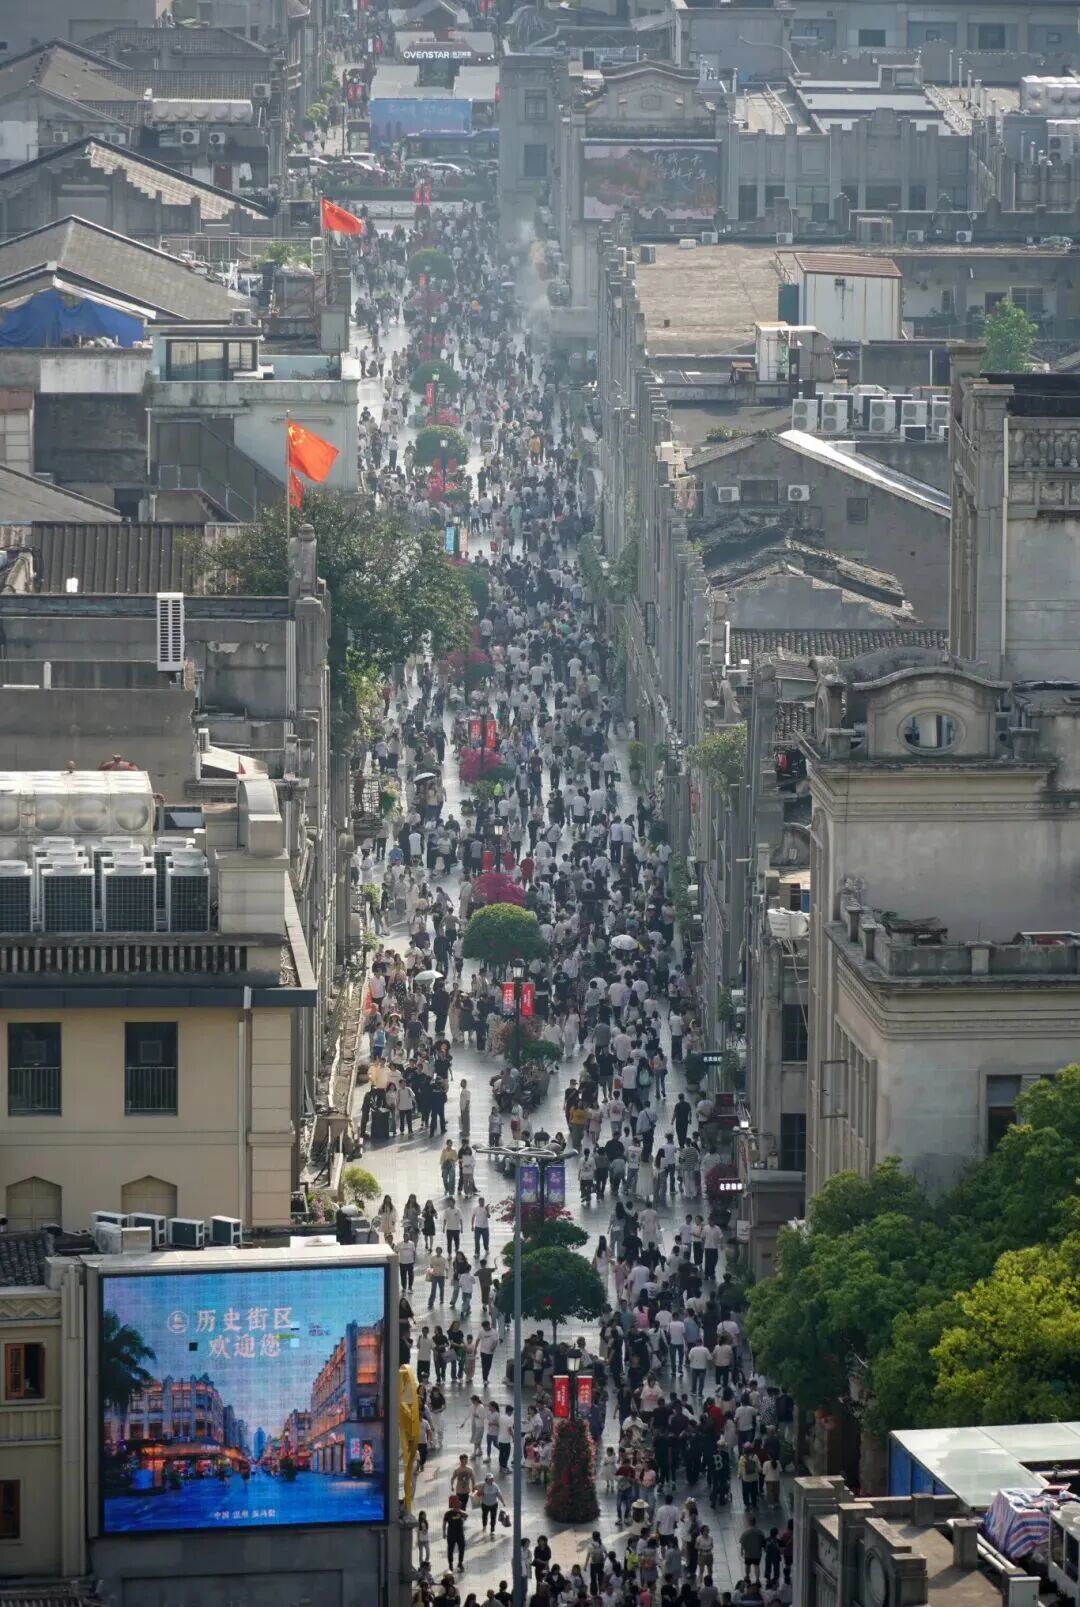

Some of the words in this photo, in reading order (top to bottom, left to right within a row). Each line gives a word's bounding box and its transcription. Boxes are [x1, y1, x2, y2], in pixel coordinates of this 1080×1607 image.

[196, 1306, 292, 1333] 历史街区
[209, 1333, 281, 1359] 欢迎您
